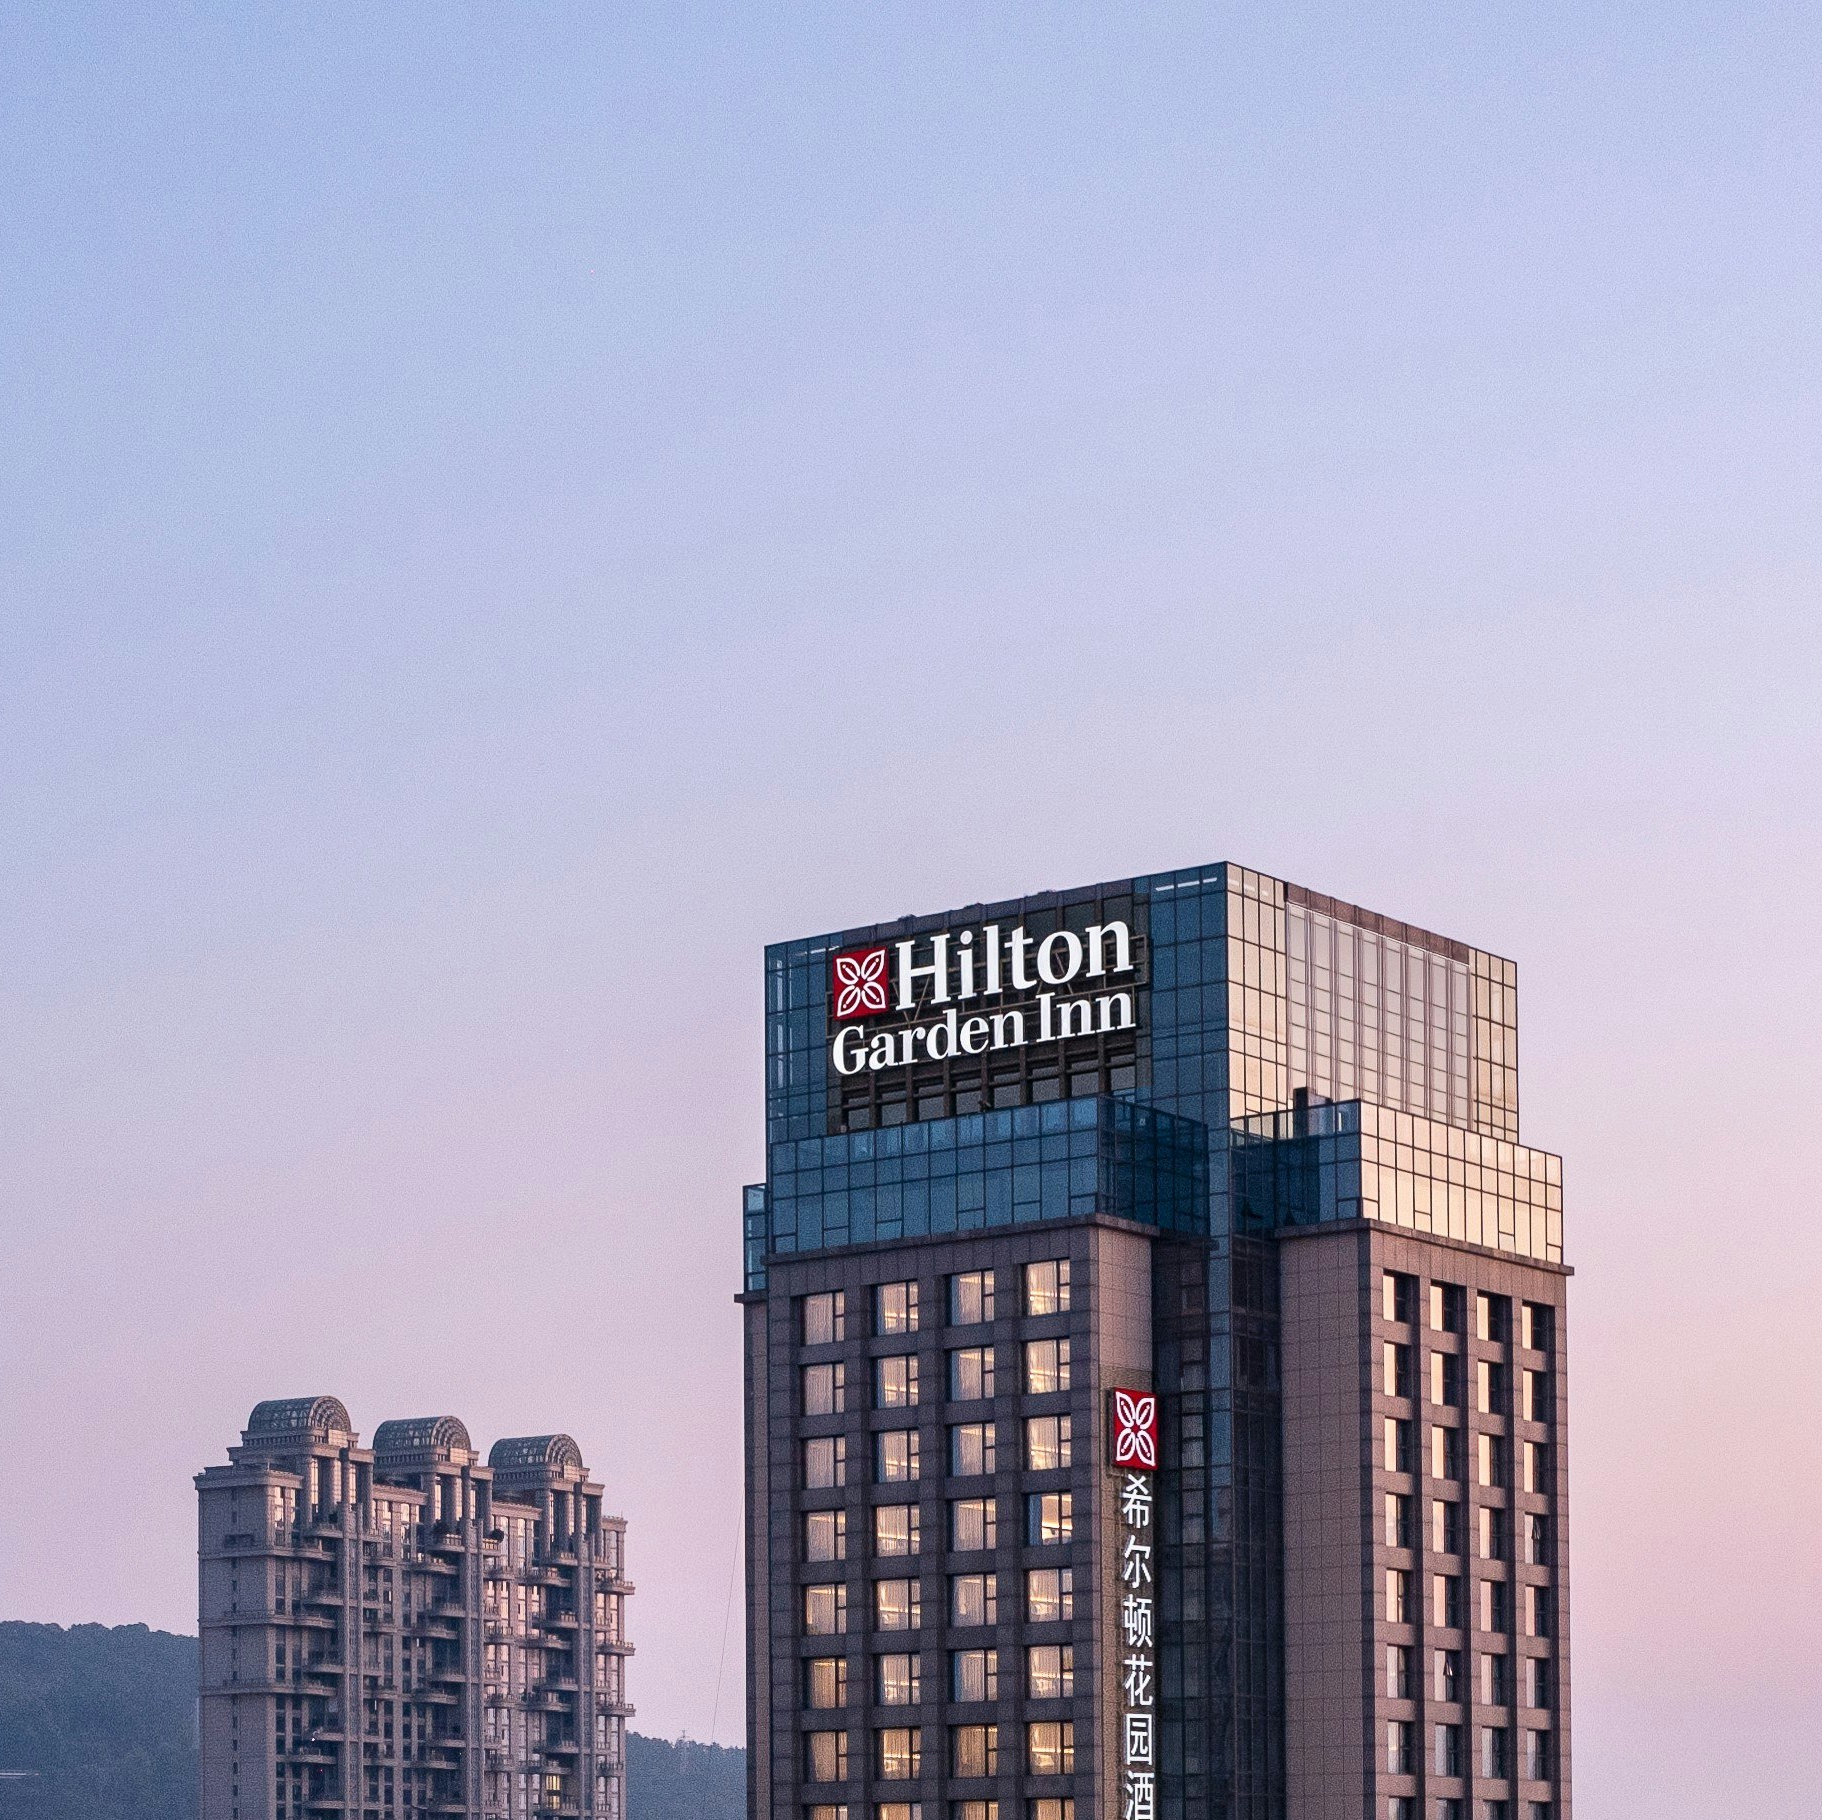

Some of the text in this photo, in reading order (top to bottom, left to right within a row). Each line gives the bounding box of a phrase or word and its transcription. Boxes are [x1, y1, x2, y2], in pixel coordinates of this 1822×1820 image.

[895, 920, 1134, 1011] Hilton
[832, 991, 1136, 1075] Garden Inn
